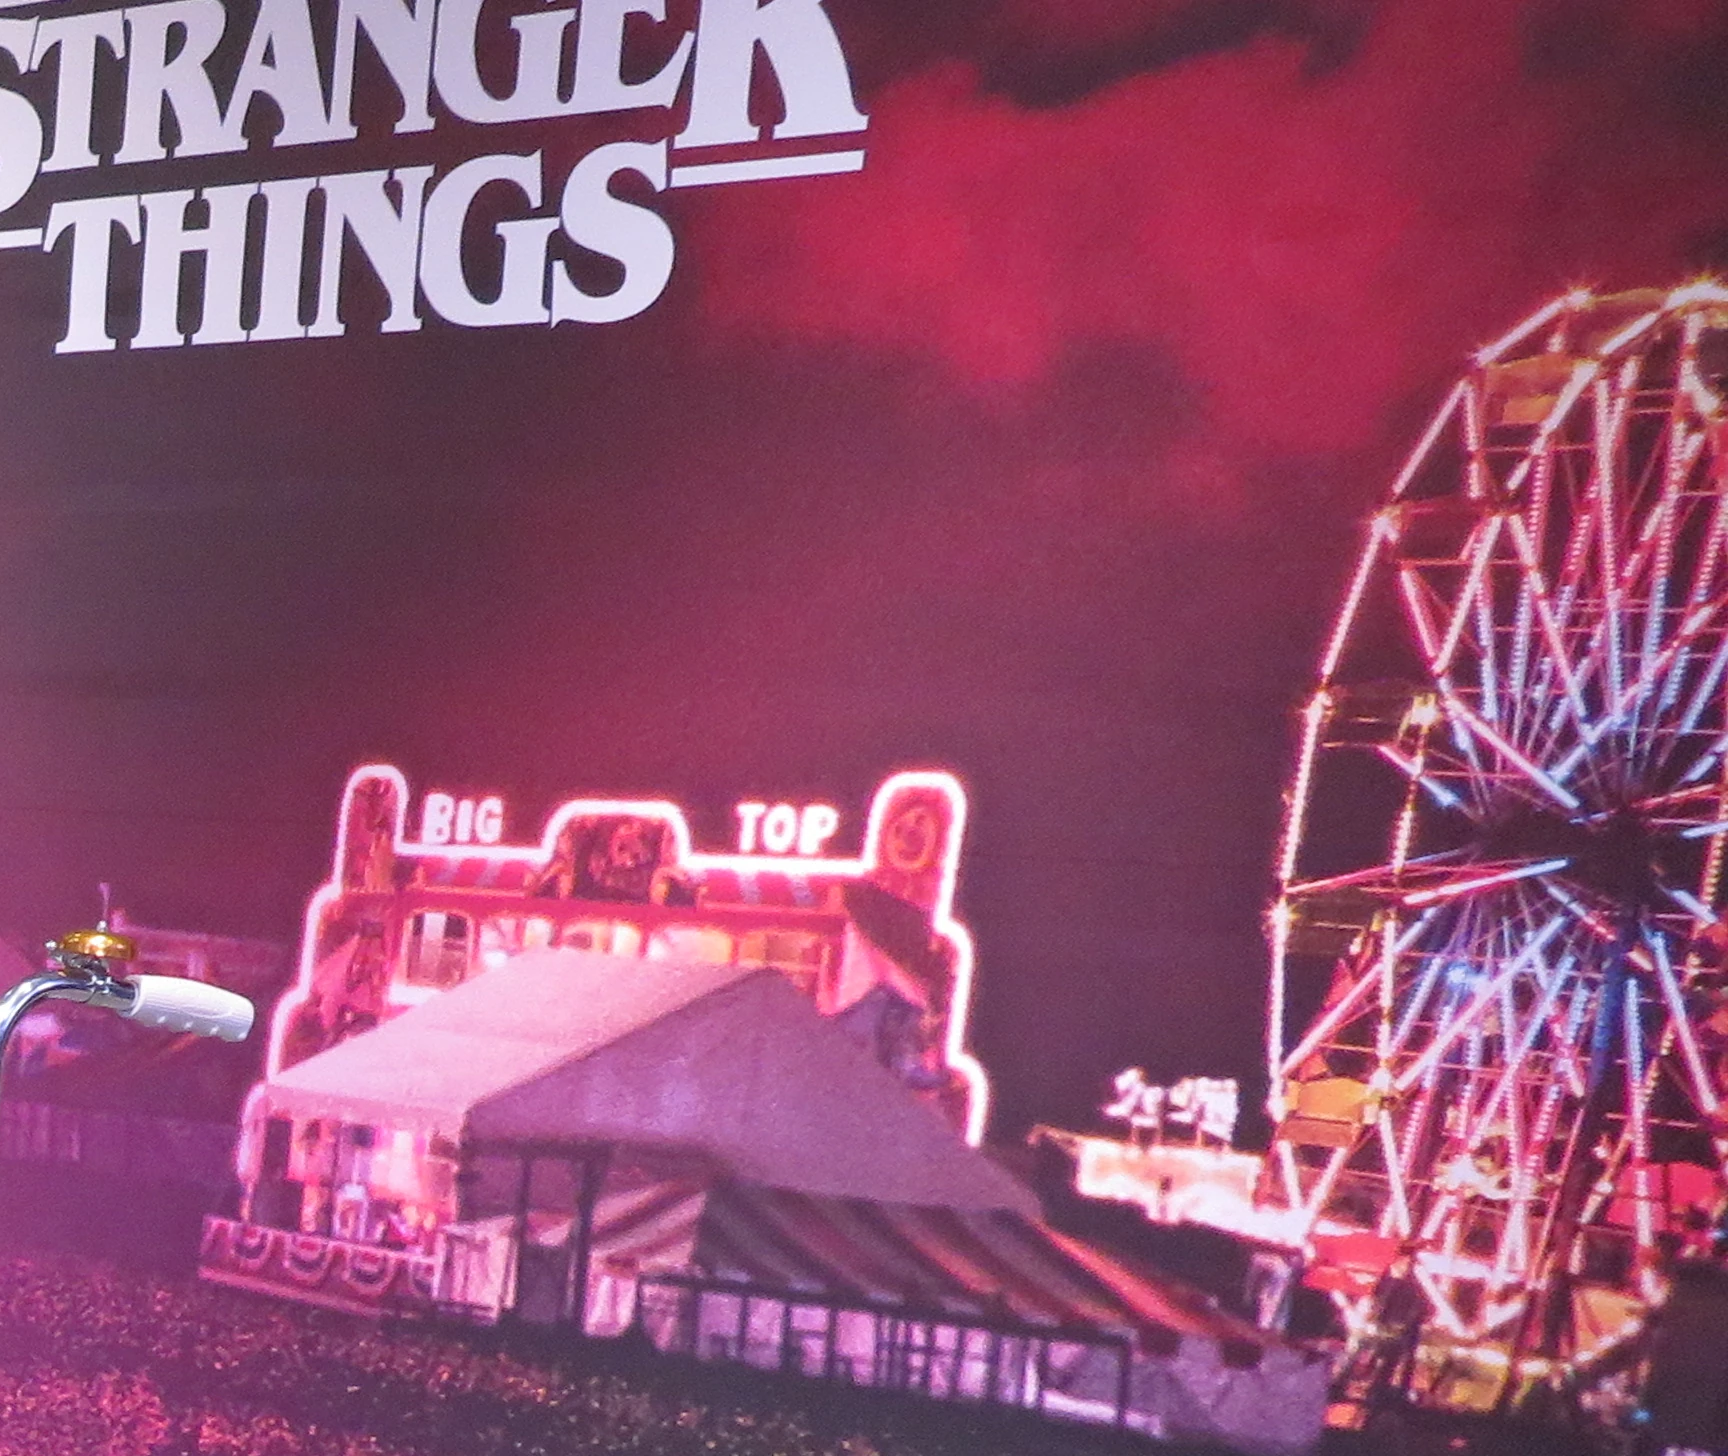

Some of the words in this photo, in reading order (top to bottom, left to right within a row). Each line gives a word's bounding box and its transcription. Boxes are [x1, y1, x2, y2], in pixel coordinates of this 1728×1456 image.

[42, 139, 676, 356] THINGS
[420, 792, 505, 845] BIG
[736, 801, 840, 855] TOP
